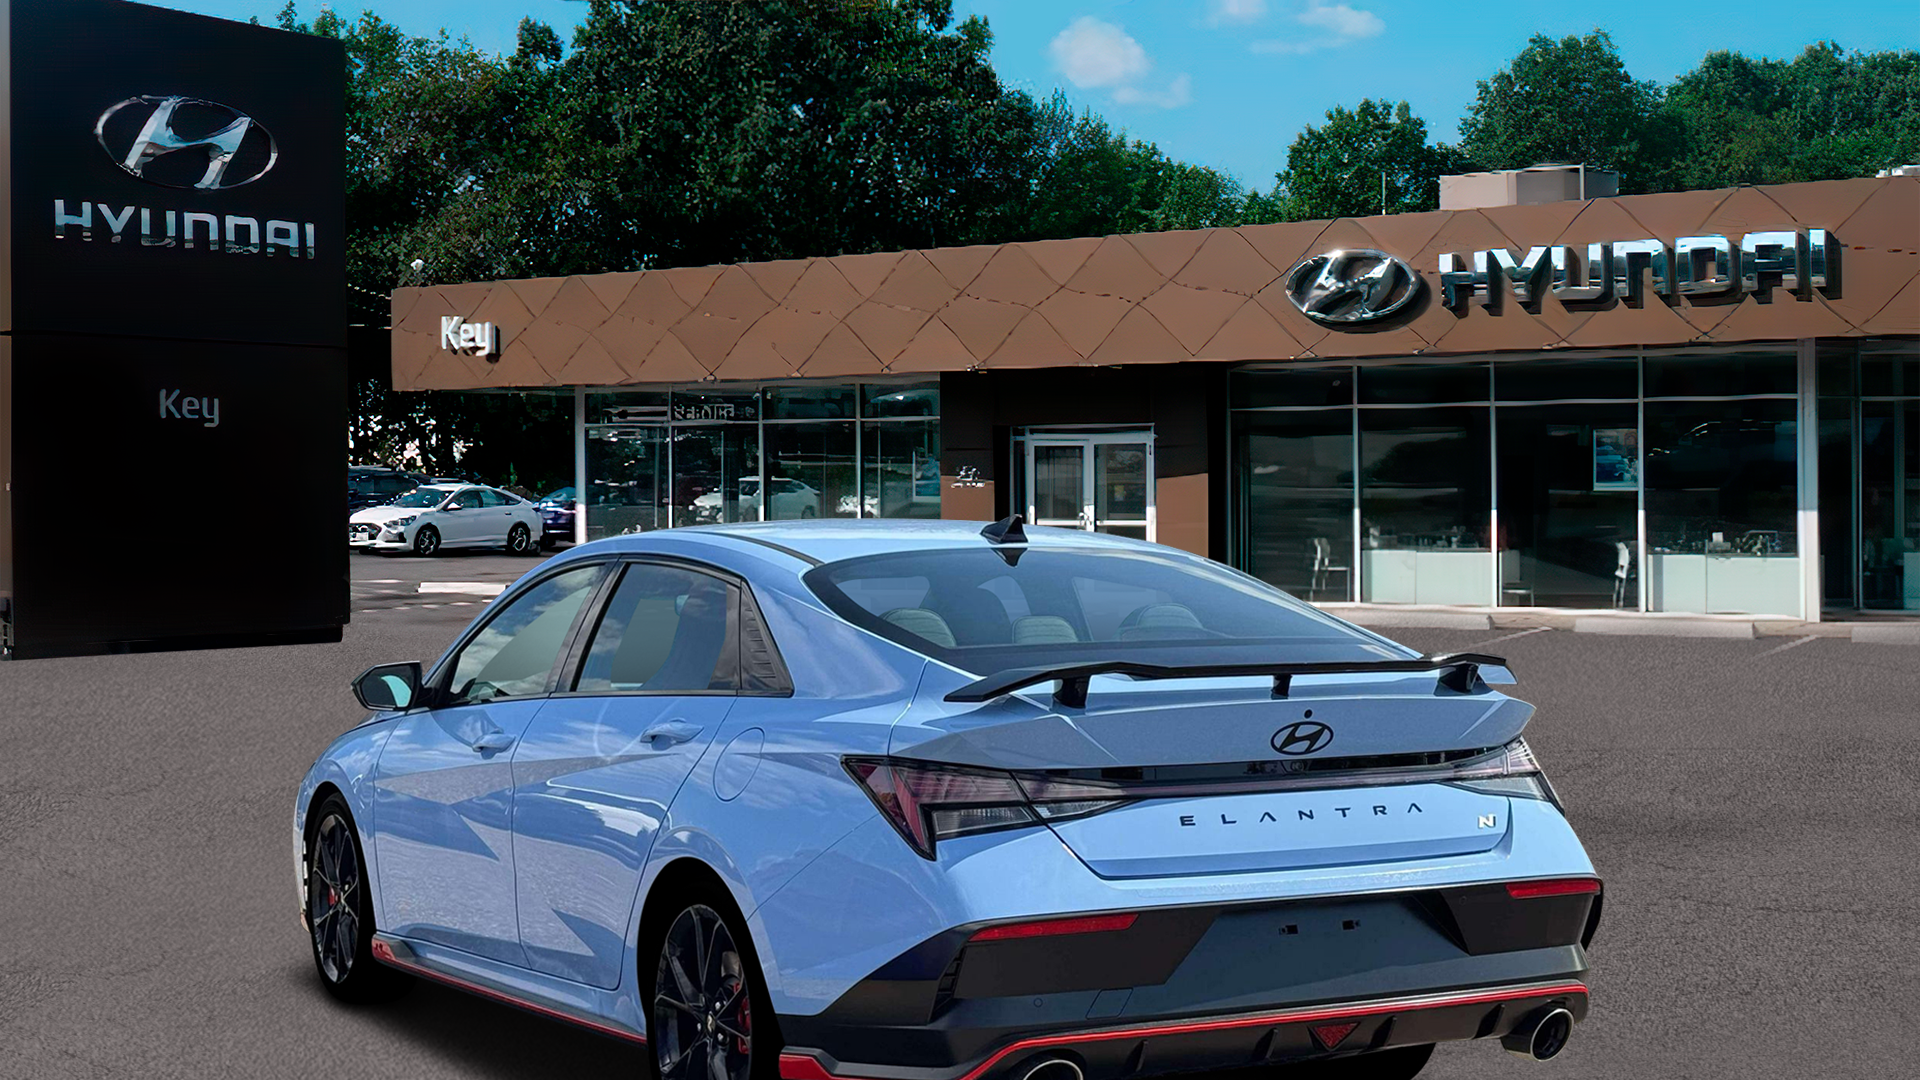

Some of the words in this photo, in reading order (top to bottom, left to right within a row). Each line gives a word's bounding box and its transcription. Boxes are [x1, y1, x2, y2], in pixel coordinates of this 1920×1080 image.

[54, 199, 315, 260] HYUNDAI
[1438, 228, 1831, 312] HYUNDAI
[441, 315, 493, 357] Key
[159, 388, 220, 428] Key
[1179, 802, 1423, 827] ELANTRA
[1478, 814, 1497, 829] N
